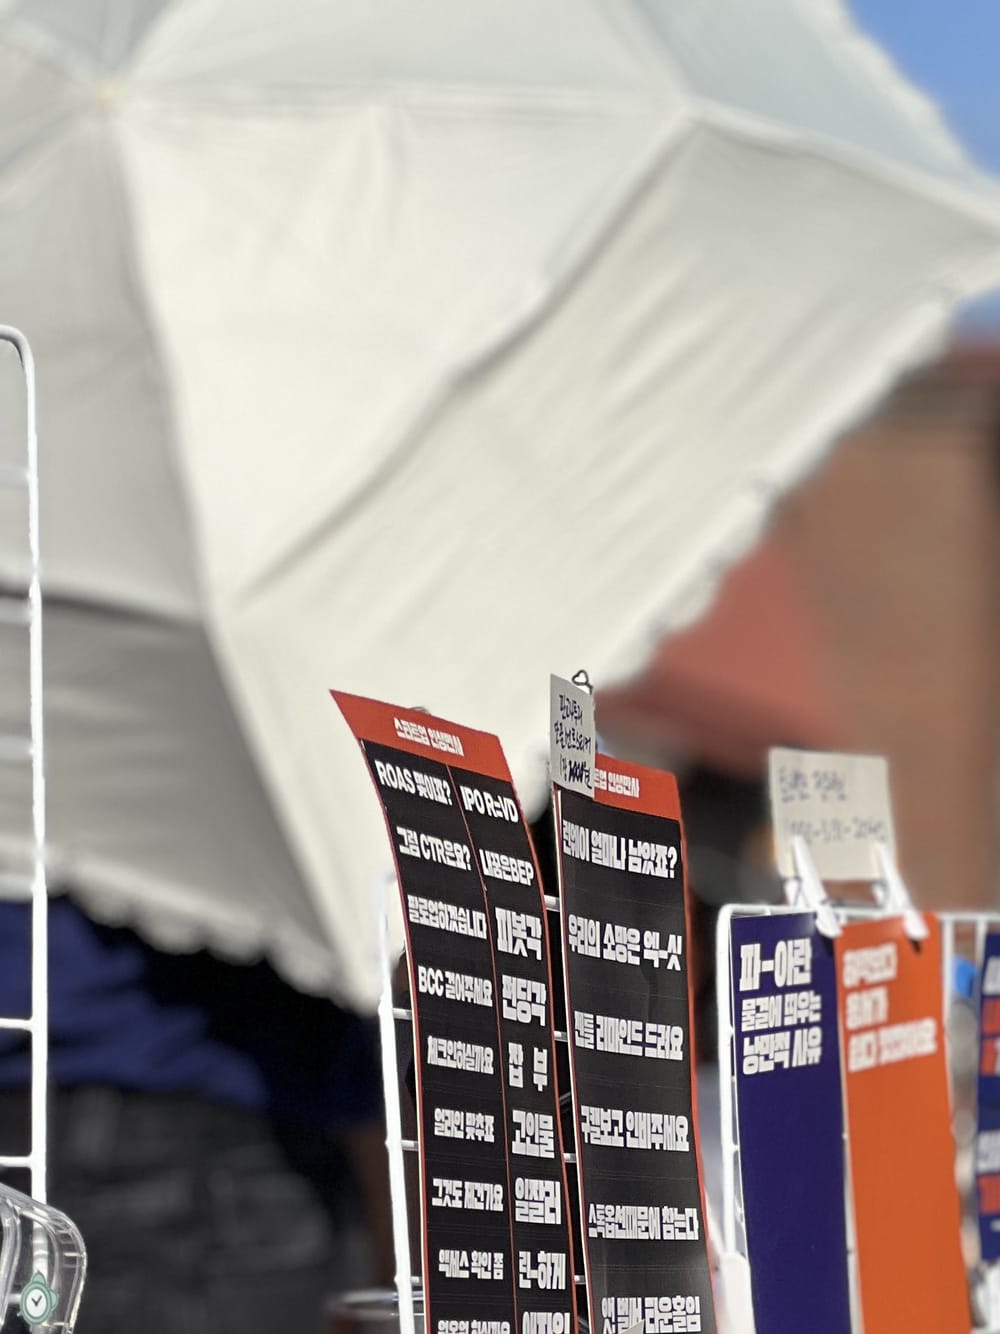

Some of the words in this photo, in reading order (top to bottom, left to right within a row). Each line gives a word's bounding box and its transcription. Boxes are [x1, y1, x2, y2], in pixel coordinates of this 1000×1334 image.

[375, 760, 416, 794] ROAS
[460, 785, 486, 815] IPO
[396, 826, 421, 858] 그럼
[628, 838, 678, 879] 남았죠?
[495, 906, 542, 961] 피봇각
[418, 965, 444, 997] BCC
[444, 970, 493, 1007] 걸어주세요
[502, 974, 546, 1026] 펀딩각
[512, 1109, 555, 1159] 고인물
